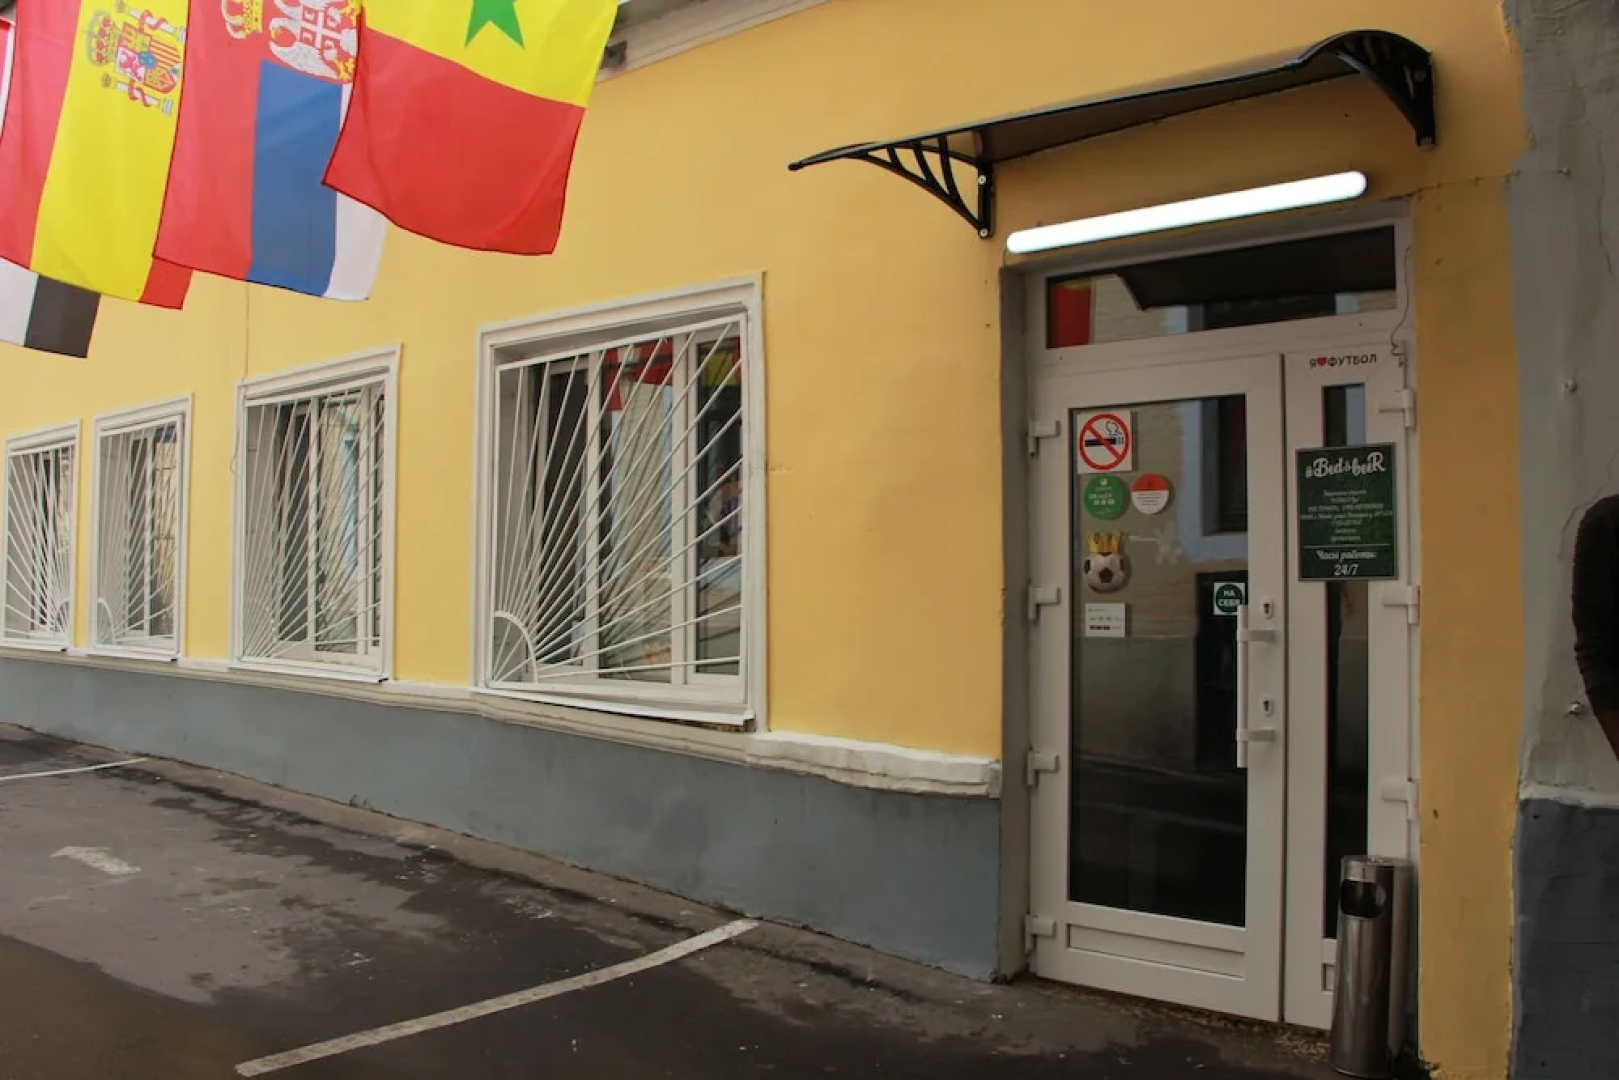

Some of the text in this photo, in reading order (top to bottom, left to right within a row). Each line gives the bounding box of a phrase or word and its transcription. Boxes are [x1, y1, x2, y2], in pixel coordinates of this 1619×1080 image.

[1328, 353, 1377, 367] ФУТБОЛ
[1334, 564, 1359, 576] 24/7
[1223, 588, 1236, 597] НА
